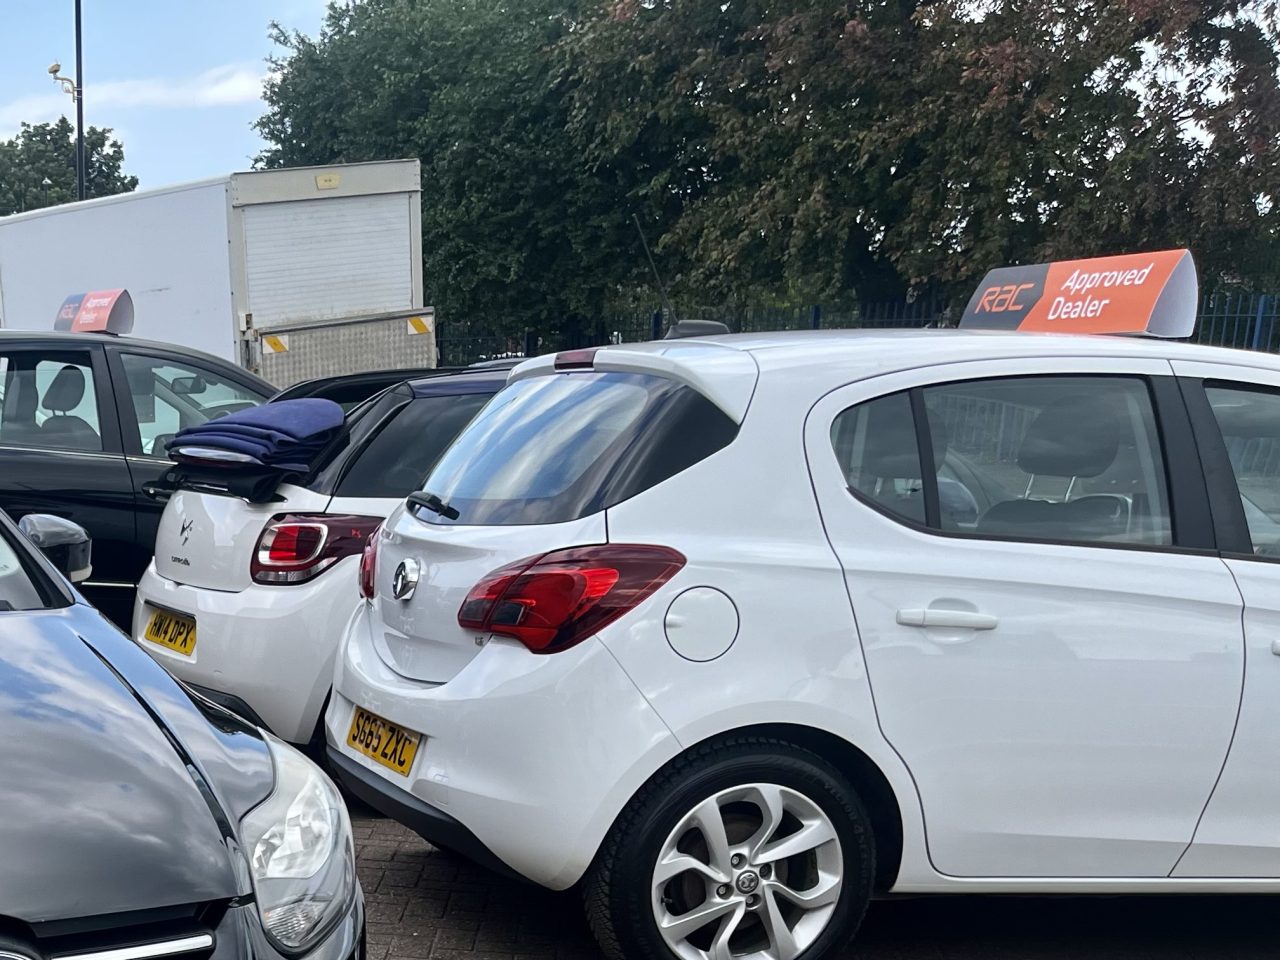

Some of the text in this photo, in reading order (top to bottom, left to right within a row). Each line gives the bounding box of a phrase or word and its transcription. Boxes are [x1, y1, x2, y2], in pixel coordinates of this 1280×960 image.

[1060, 263, 1154, 295] Approved
[1047, 295, 1110, 320] Dealer
[168, 620, 195, 648] DPX
[352, 711, 412, 767] SG65 ZXC
